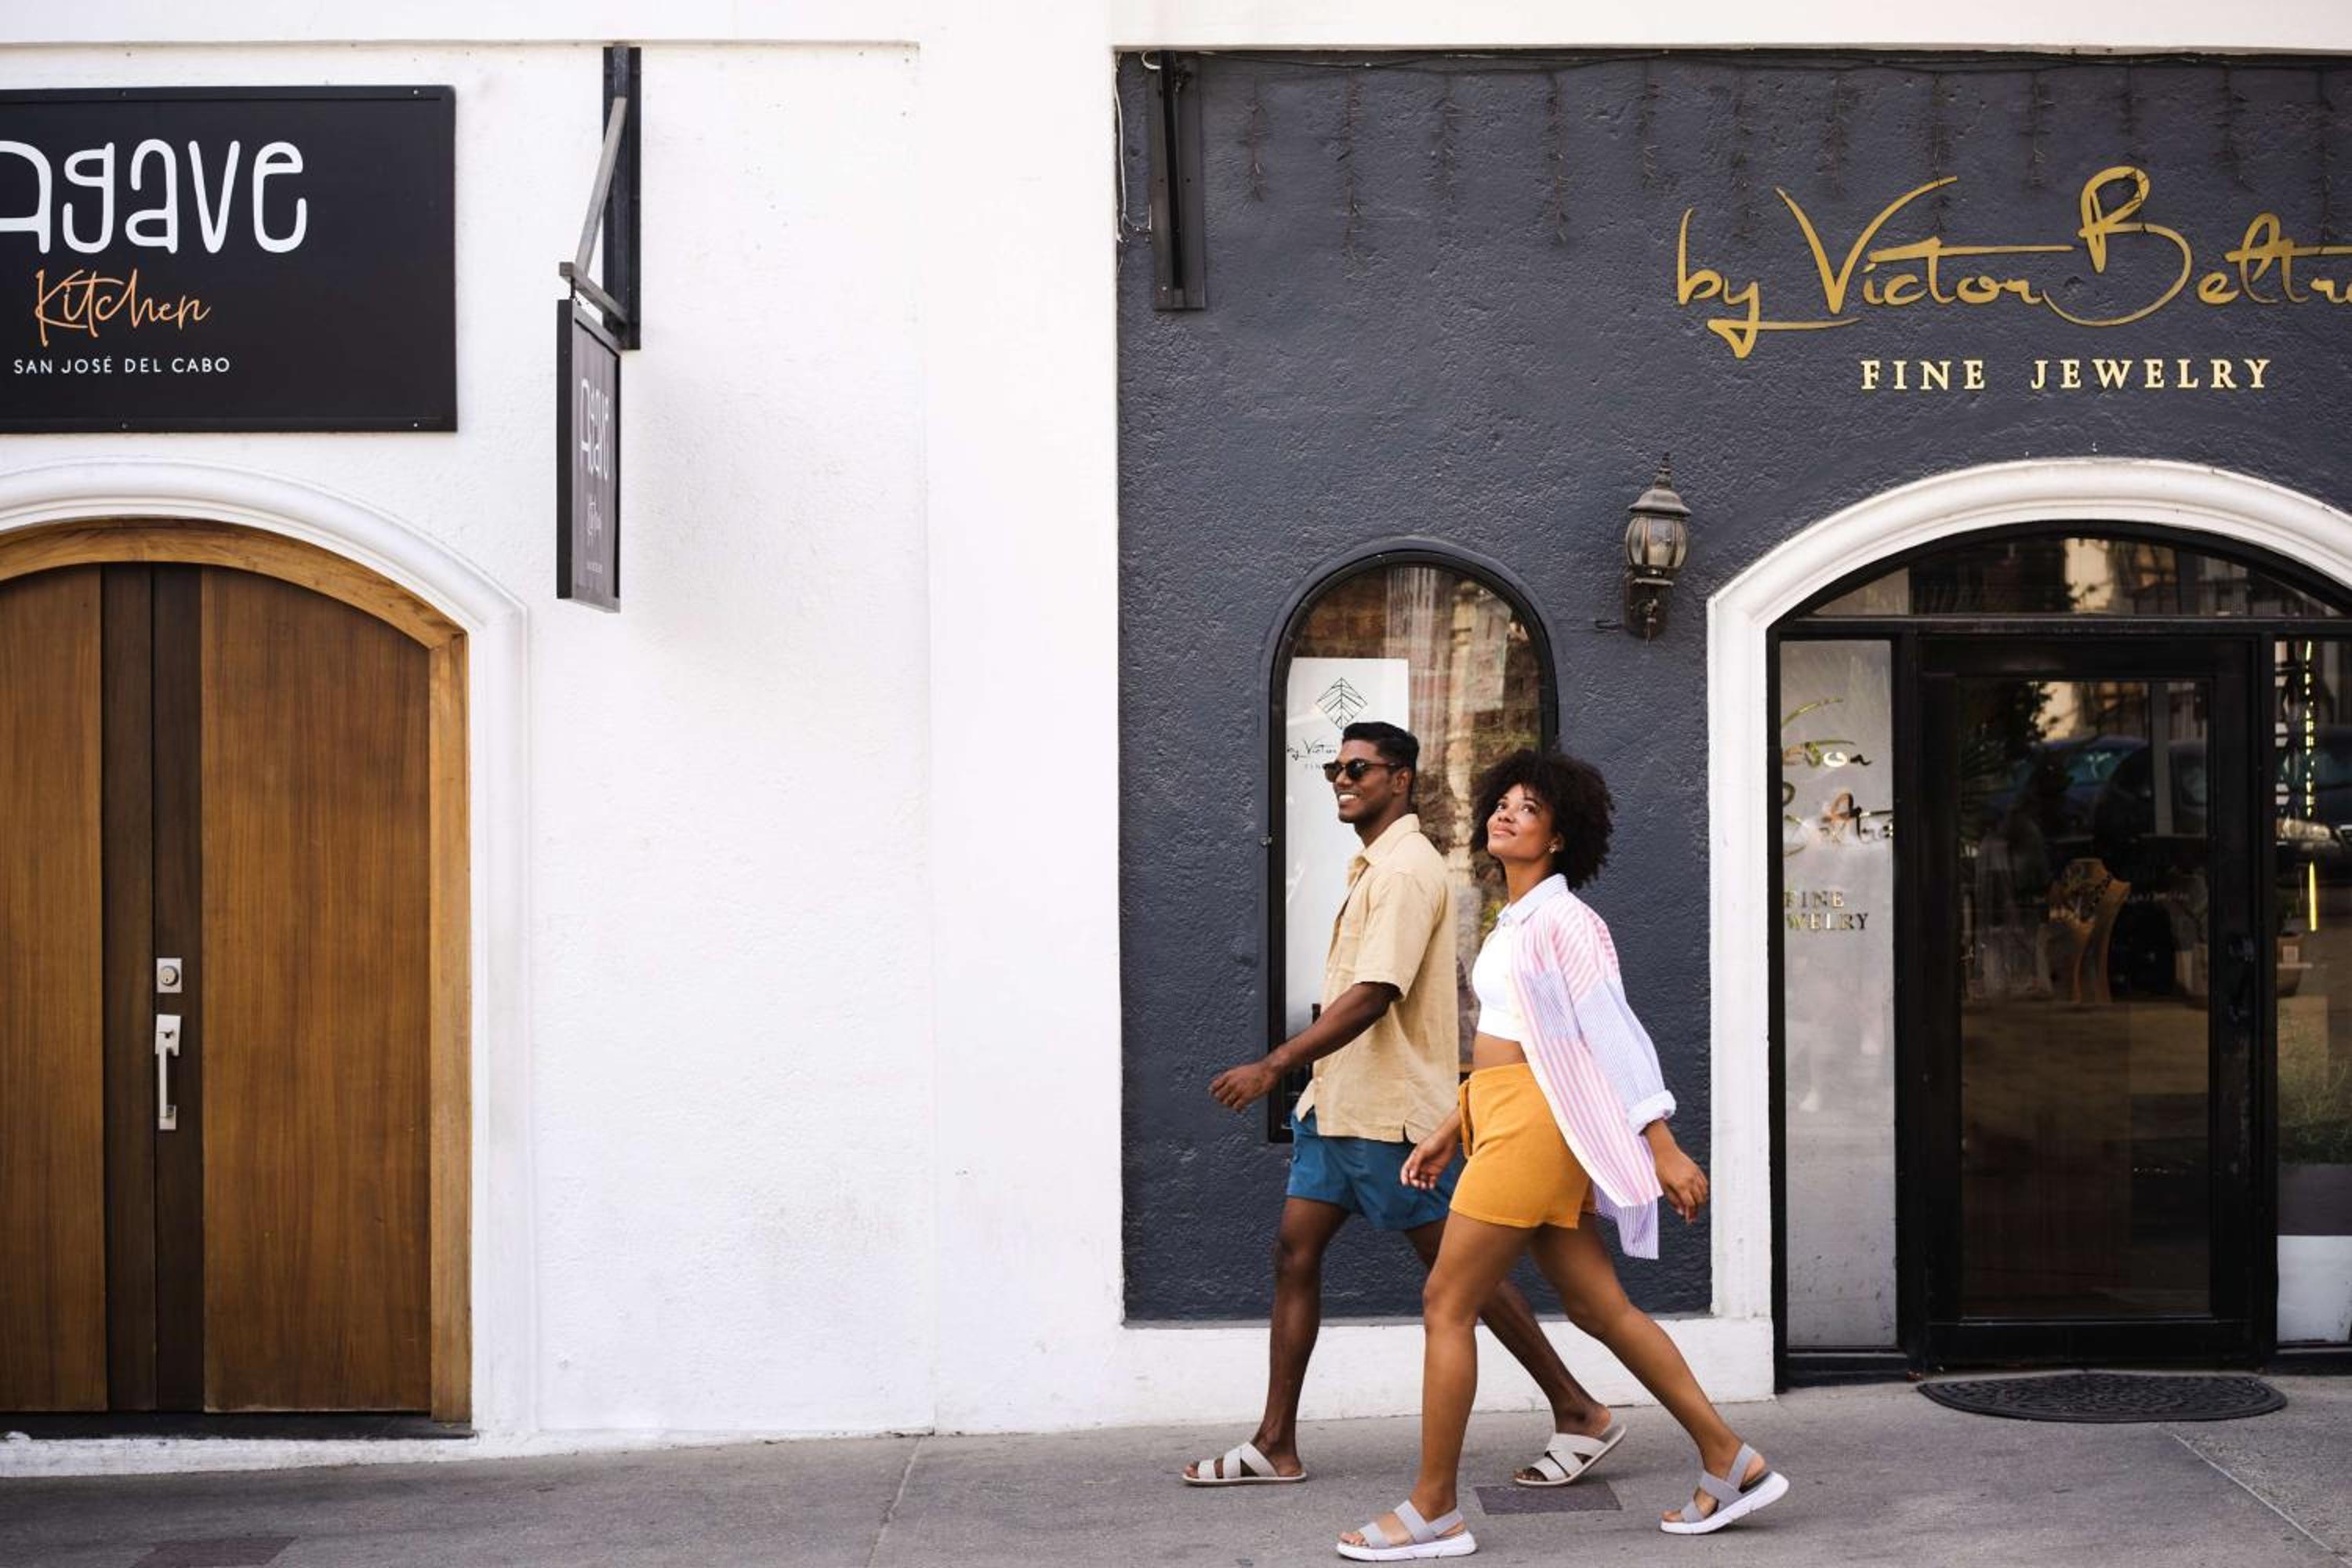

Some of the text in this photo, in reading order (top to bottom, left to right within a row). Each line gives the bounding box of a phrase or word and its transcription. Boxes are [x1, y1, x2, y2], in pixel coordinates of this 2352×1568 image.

[1677, 165, 2352, 359] by Victor Beltr
[34, 268, 212, 347] Kitchen
[13, 355, 230, 374] SAN JOSÉ DEL CABO
[1860, 358, 2272, 391] FINE JEWELRY
[1784, 891, 1845, 909] FINE
[1786, 913, 1868, 931] WELRY
